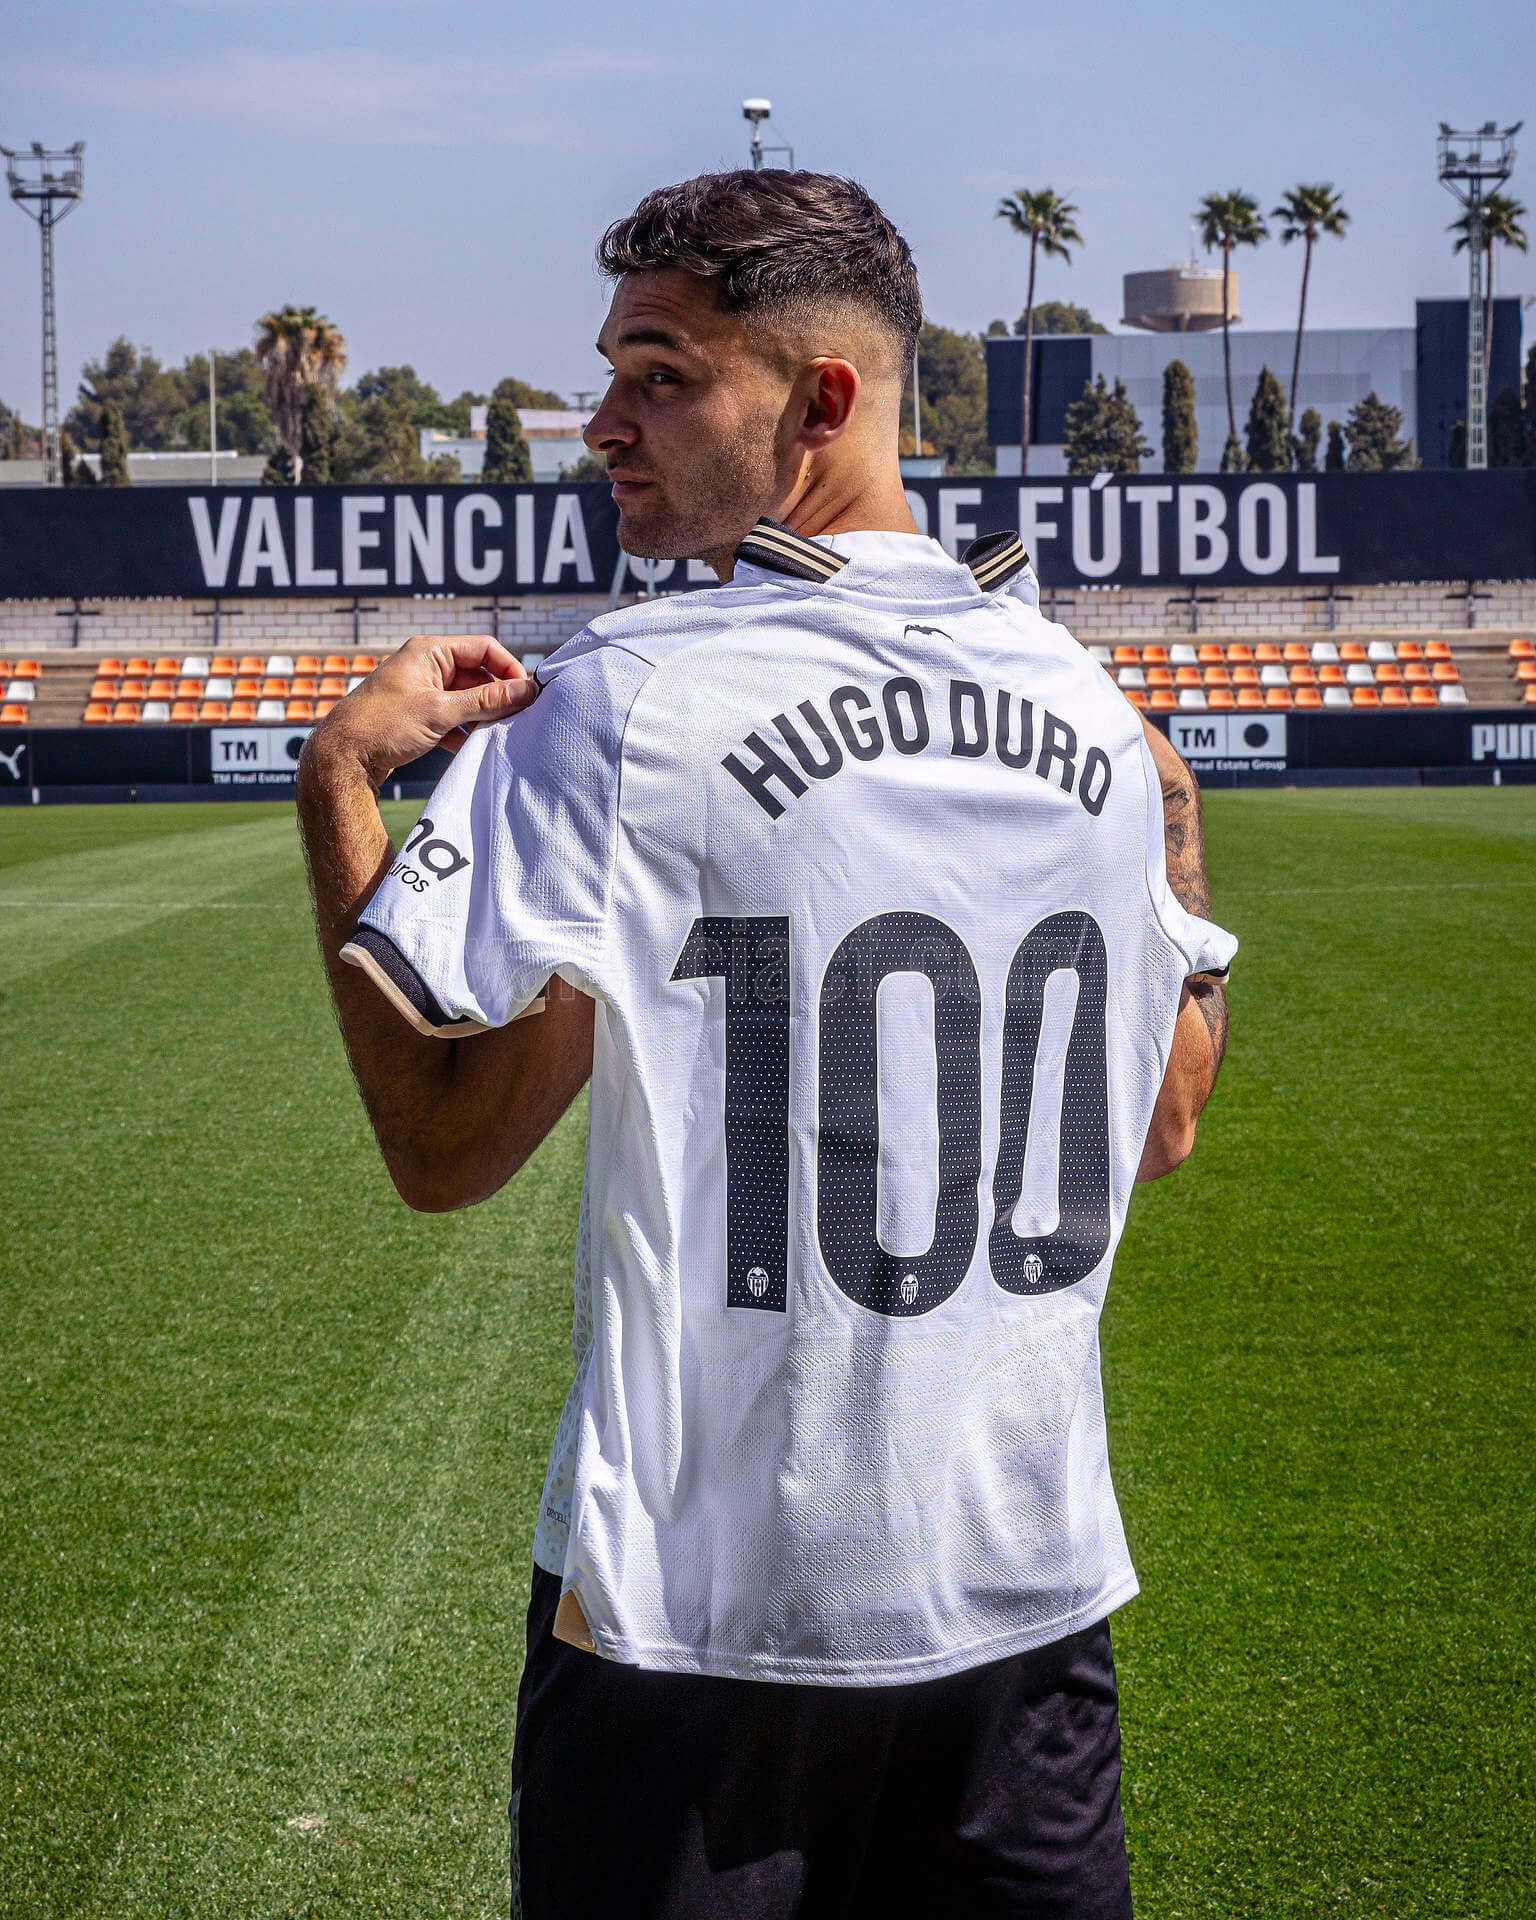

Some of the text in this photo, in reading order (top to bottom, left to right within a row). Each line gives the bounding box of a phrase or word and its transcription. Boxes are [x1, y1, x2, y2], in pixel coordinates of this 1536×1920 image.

[188, 494, 595, 588] VALENCIA
[1019, 473, 1340, 578] FÚTBOL
[1178, 728, 1215, 748] TM
[221, 742, 257, 760] TM
[720, 676, 1112, 821] HUGO DURO
[1216, 760, 1250, 771] Estate
[1251, 760, 1286, 772] Group
[233, 773, 257, 784] Real
[258, 772, 293, 784] Estate
[667, 908, 1111, 1319] 100
